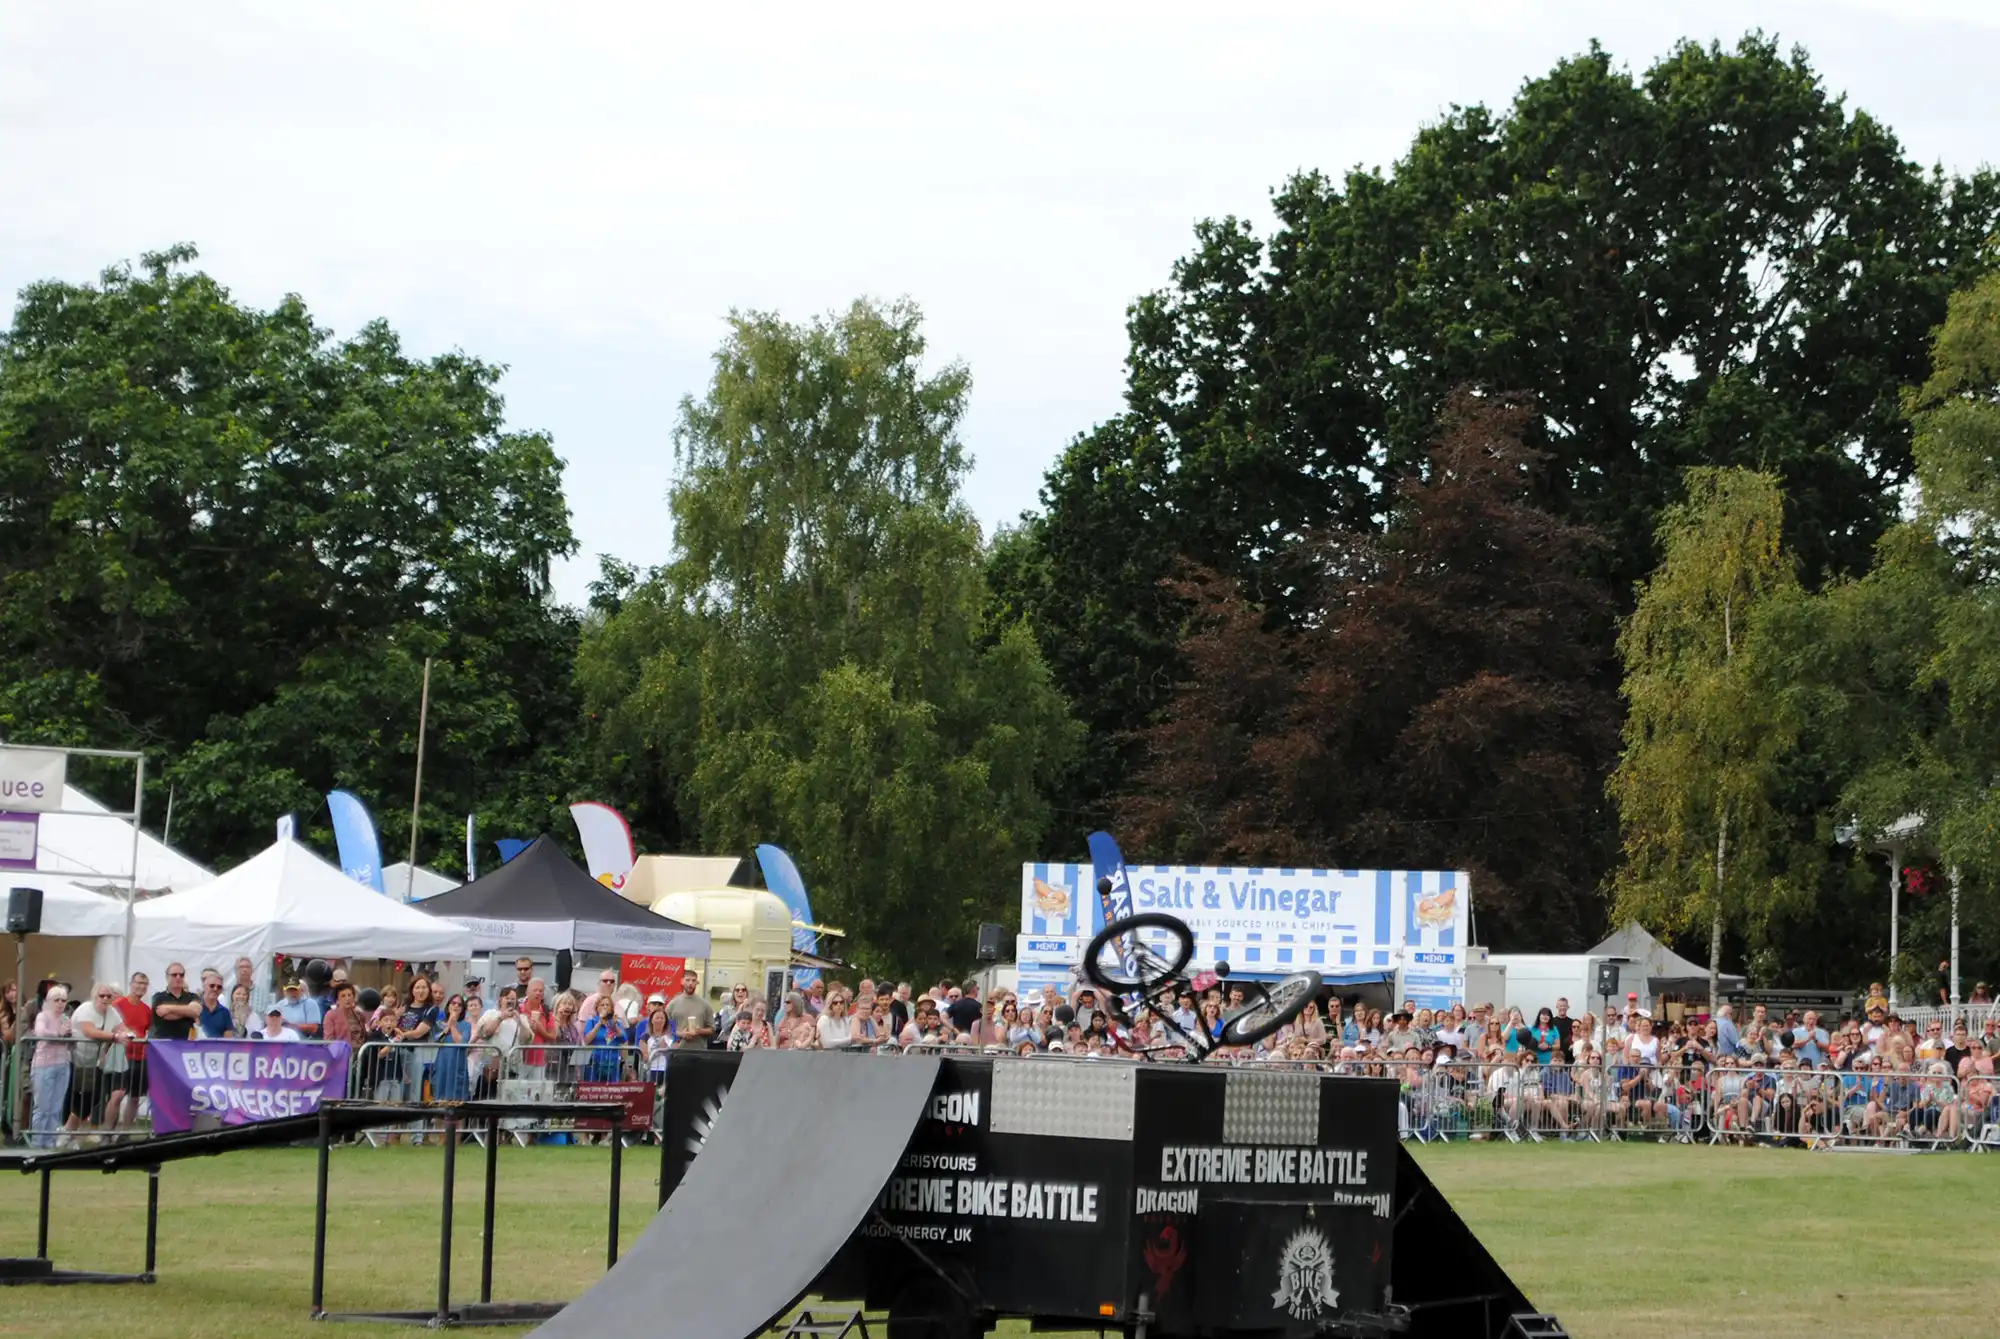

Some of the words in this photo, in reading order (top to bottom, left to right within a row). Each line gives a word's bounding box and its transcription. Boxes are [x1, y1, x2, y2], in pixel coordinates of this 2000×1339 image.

[1138, 876, 1194, 909] Salt
[1202, 879, 1221, 909] &
[1228, 880, 1342, 919] Vinegar
[1216, 919, 1261, 929] SOURCED
[1266, 921, 1286, 930] FISH
[1301, 921, 1332, 931] CHIPS
[1036, 941, 1059, 950] MENU
[1422, 954, 1446, 963] MENU
[185, 1055, 247, 1078] BBC
[255, 1057, 327, 1082] RADIO
[190, 1085, 323, 1118] SOMERSET
[927, 1092, 980, 1126] GON
[1161, 1147, 1252, 1183] EXTREME
[1254, 1149, 1297, 1184] BIKE
[1300, 1150, 1368, 1185] BATTLE
[956, 1179, 1008, 1217] BIKE
[1011, 1182, 1099, 1223] BATTLE
[1136, 1187, 1198, 1215] DRAGON
[1290, 1269, 1323, 1291] BIKE
[1288, 1302, 1322, 1321] BATTLE
